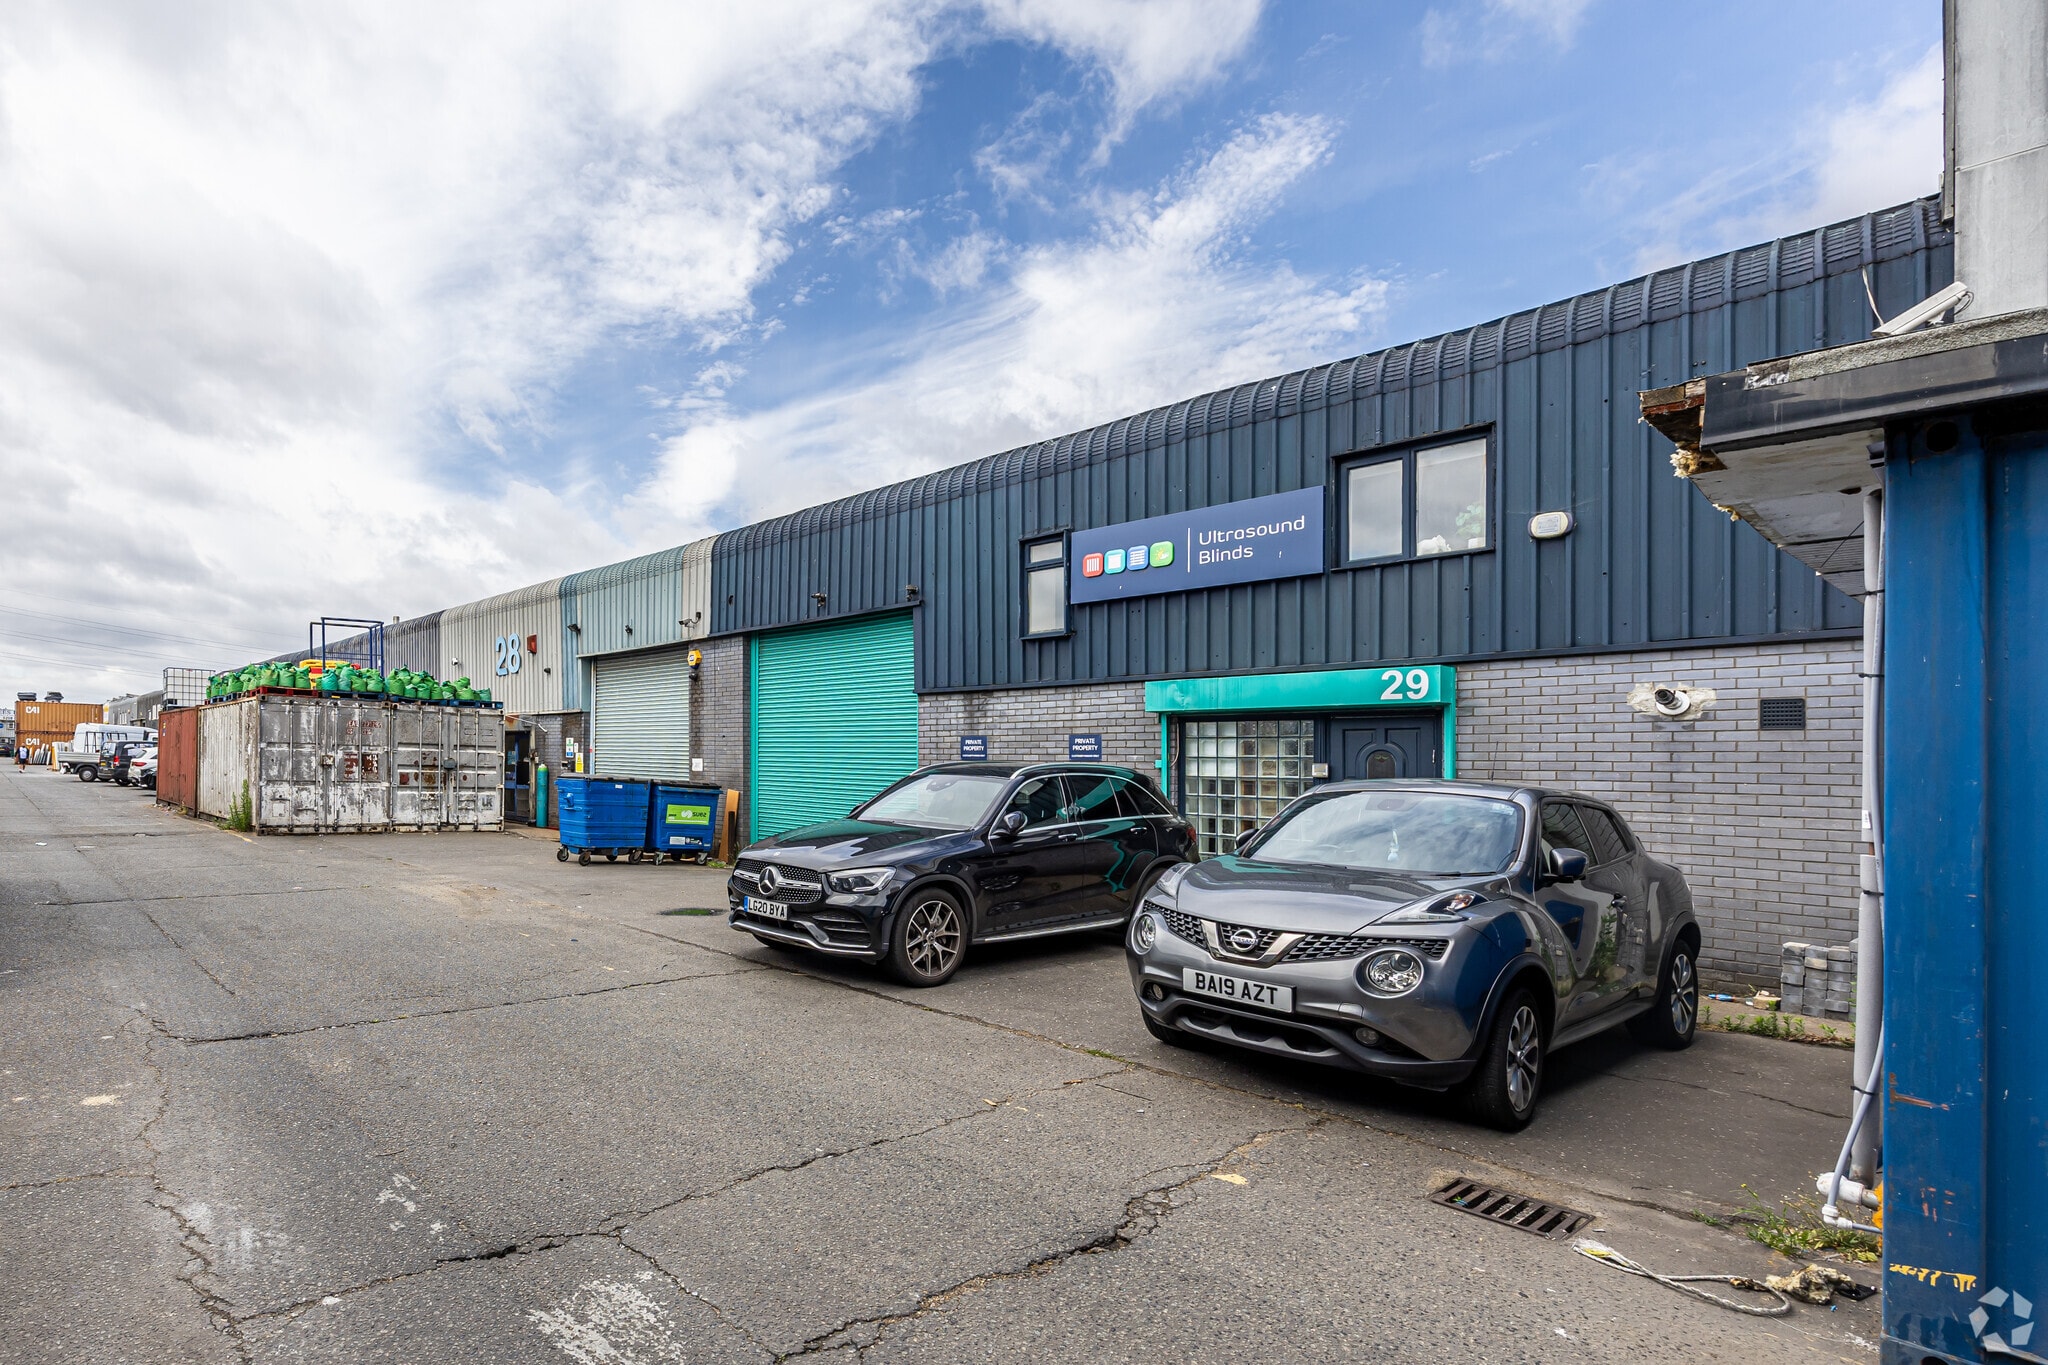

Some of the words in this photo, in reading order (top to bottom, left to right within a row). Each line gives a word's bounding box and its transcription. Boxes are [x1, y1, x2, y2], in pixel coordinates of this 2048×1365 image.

[1199, 515, 1305, 545] Ultrasound
[1199, 545, 1254, 565] Blinds
[495, 633, 522, 677] 28
[1380, 669, 1429, 701] 29
[25, 706, 40, 714] CAI
[25, 738, 40, 746] CAI
[748, 899, 768, 914] LG20
[769, 903, 786, 918] BYA
[1195, 972, 1235, 996] BA19
[1241, 982, 1278, 1005] AZT
